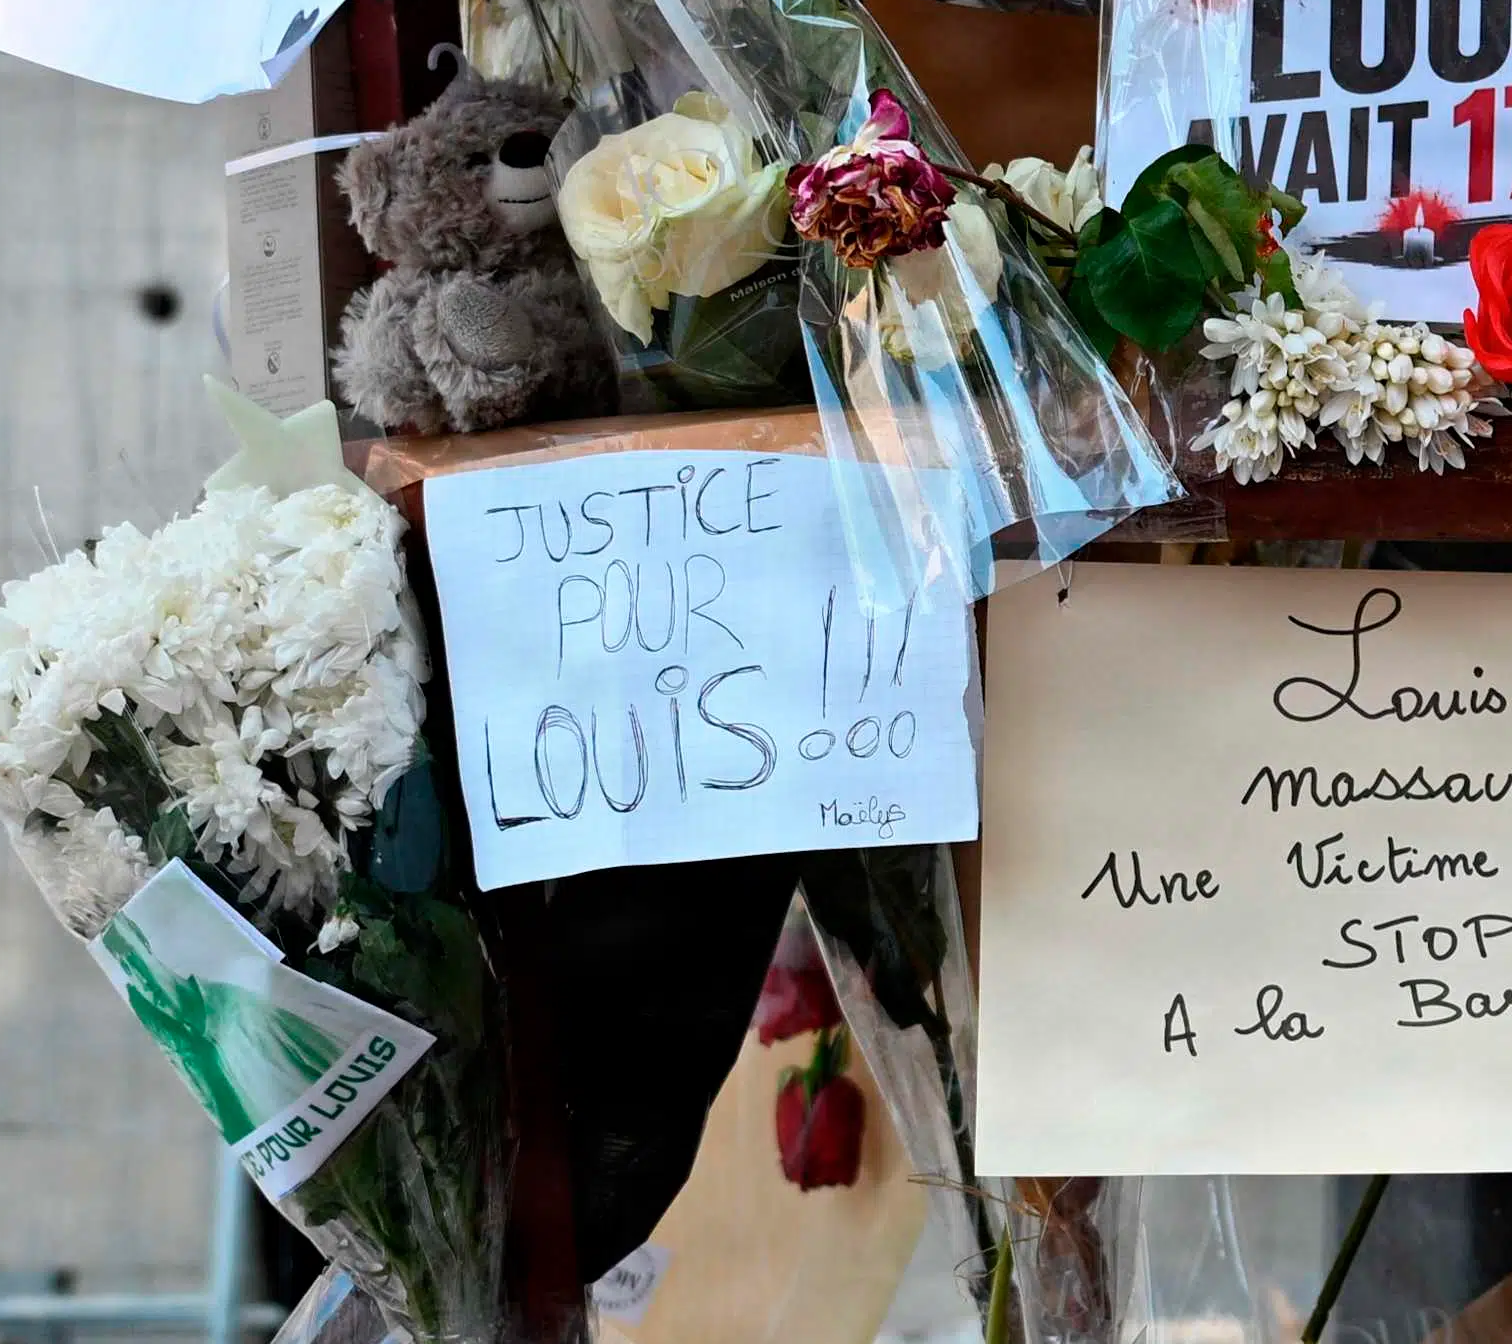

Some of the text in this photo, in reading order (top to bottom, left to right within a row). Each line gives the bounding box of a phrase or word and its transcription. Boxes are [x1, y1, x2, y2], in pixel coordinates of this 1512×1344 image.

[729, 271, 787, 302] Maison
[557, 553, 745, 680] POUR
[1272, 586, 1508, 722] Louis
[1082, 850, 1221, 911] Une
[1286, 833, 1500, 891] Victime
[1161, 993, 1198, 1058] A
[1235, 984, 1326, 1044] la
